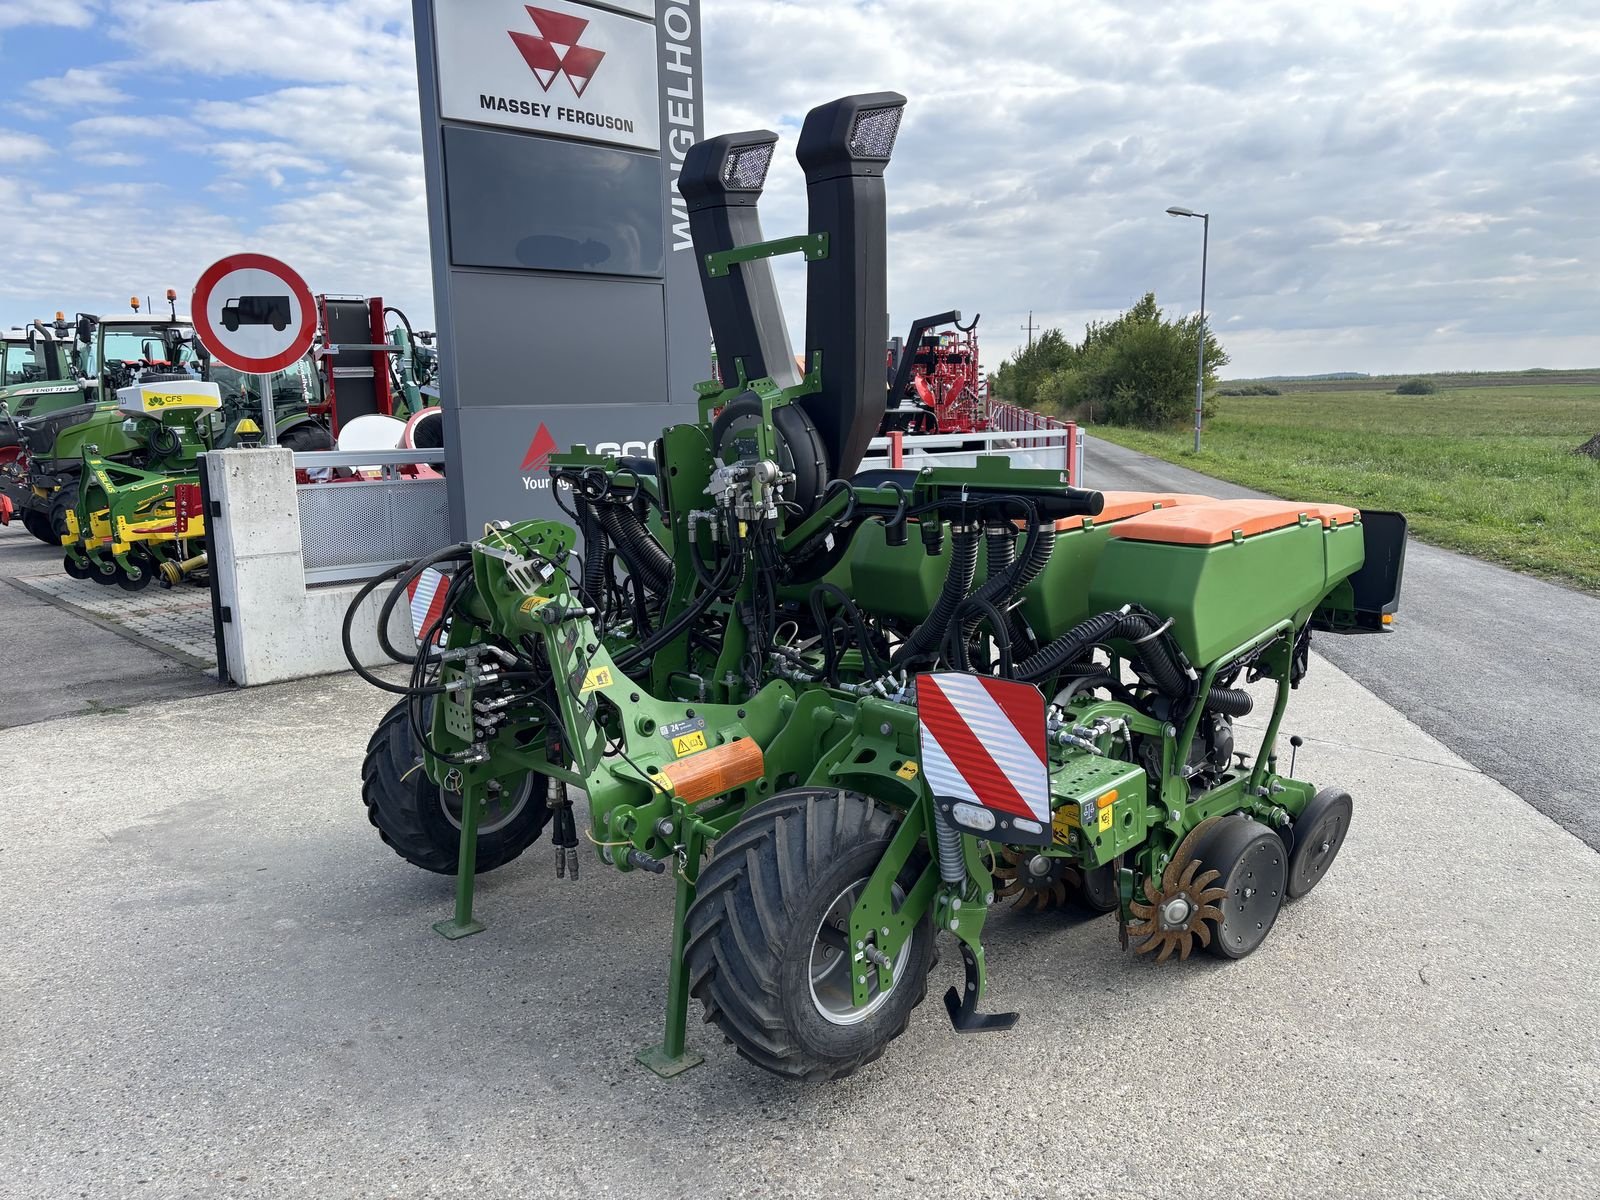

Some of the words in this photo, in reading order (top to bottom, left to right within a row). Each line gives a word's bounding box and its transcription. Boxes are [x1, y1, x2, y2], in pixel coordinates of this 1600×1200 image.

[479, 94, 551, 118] MASSEY
[557, 106, 634, 133] FERGUSON
[522, 476, 550, 490] Your
[670, 723, 680, 732] 24
